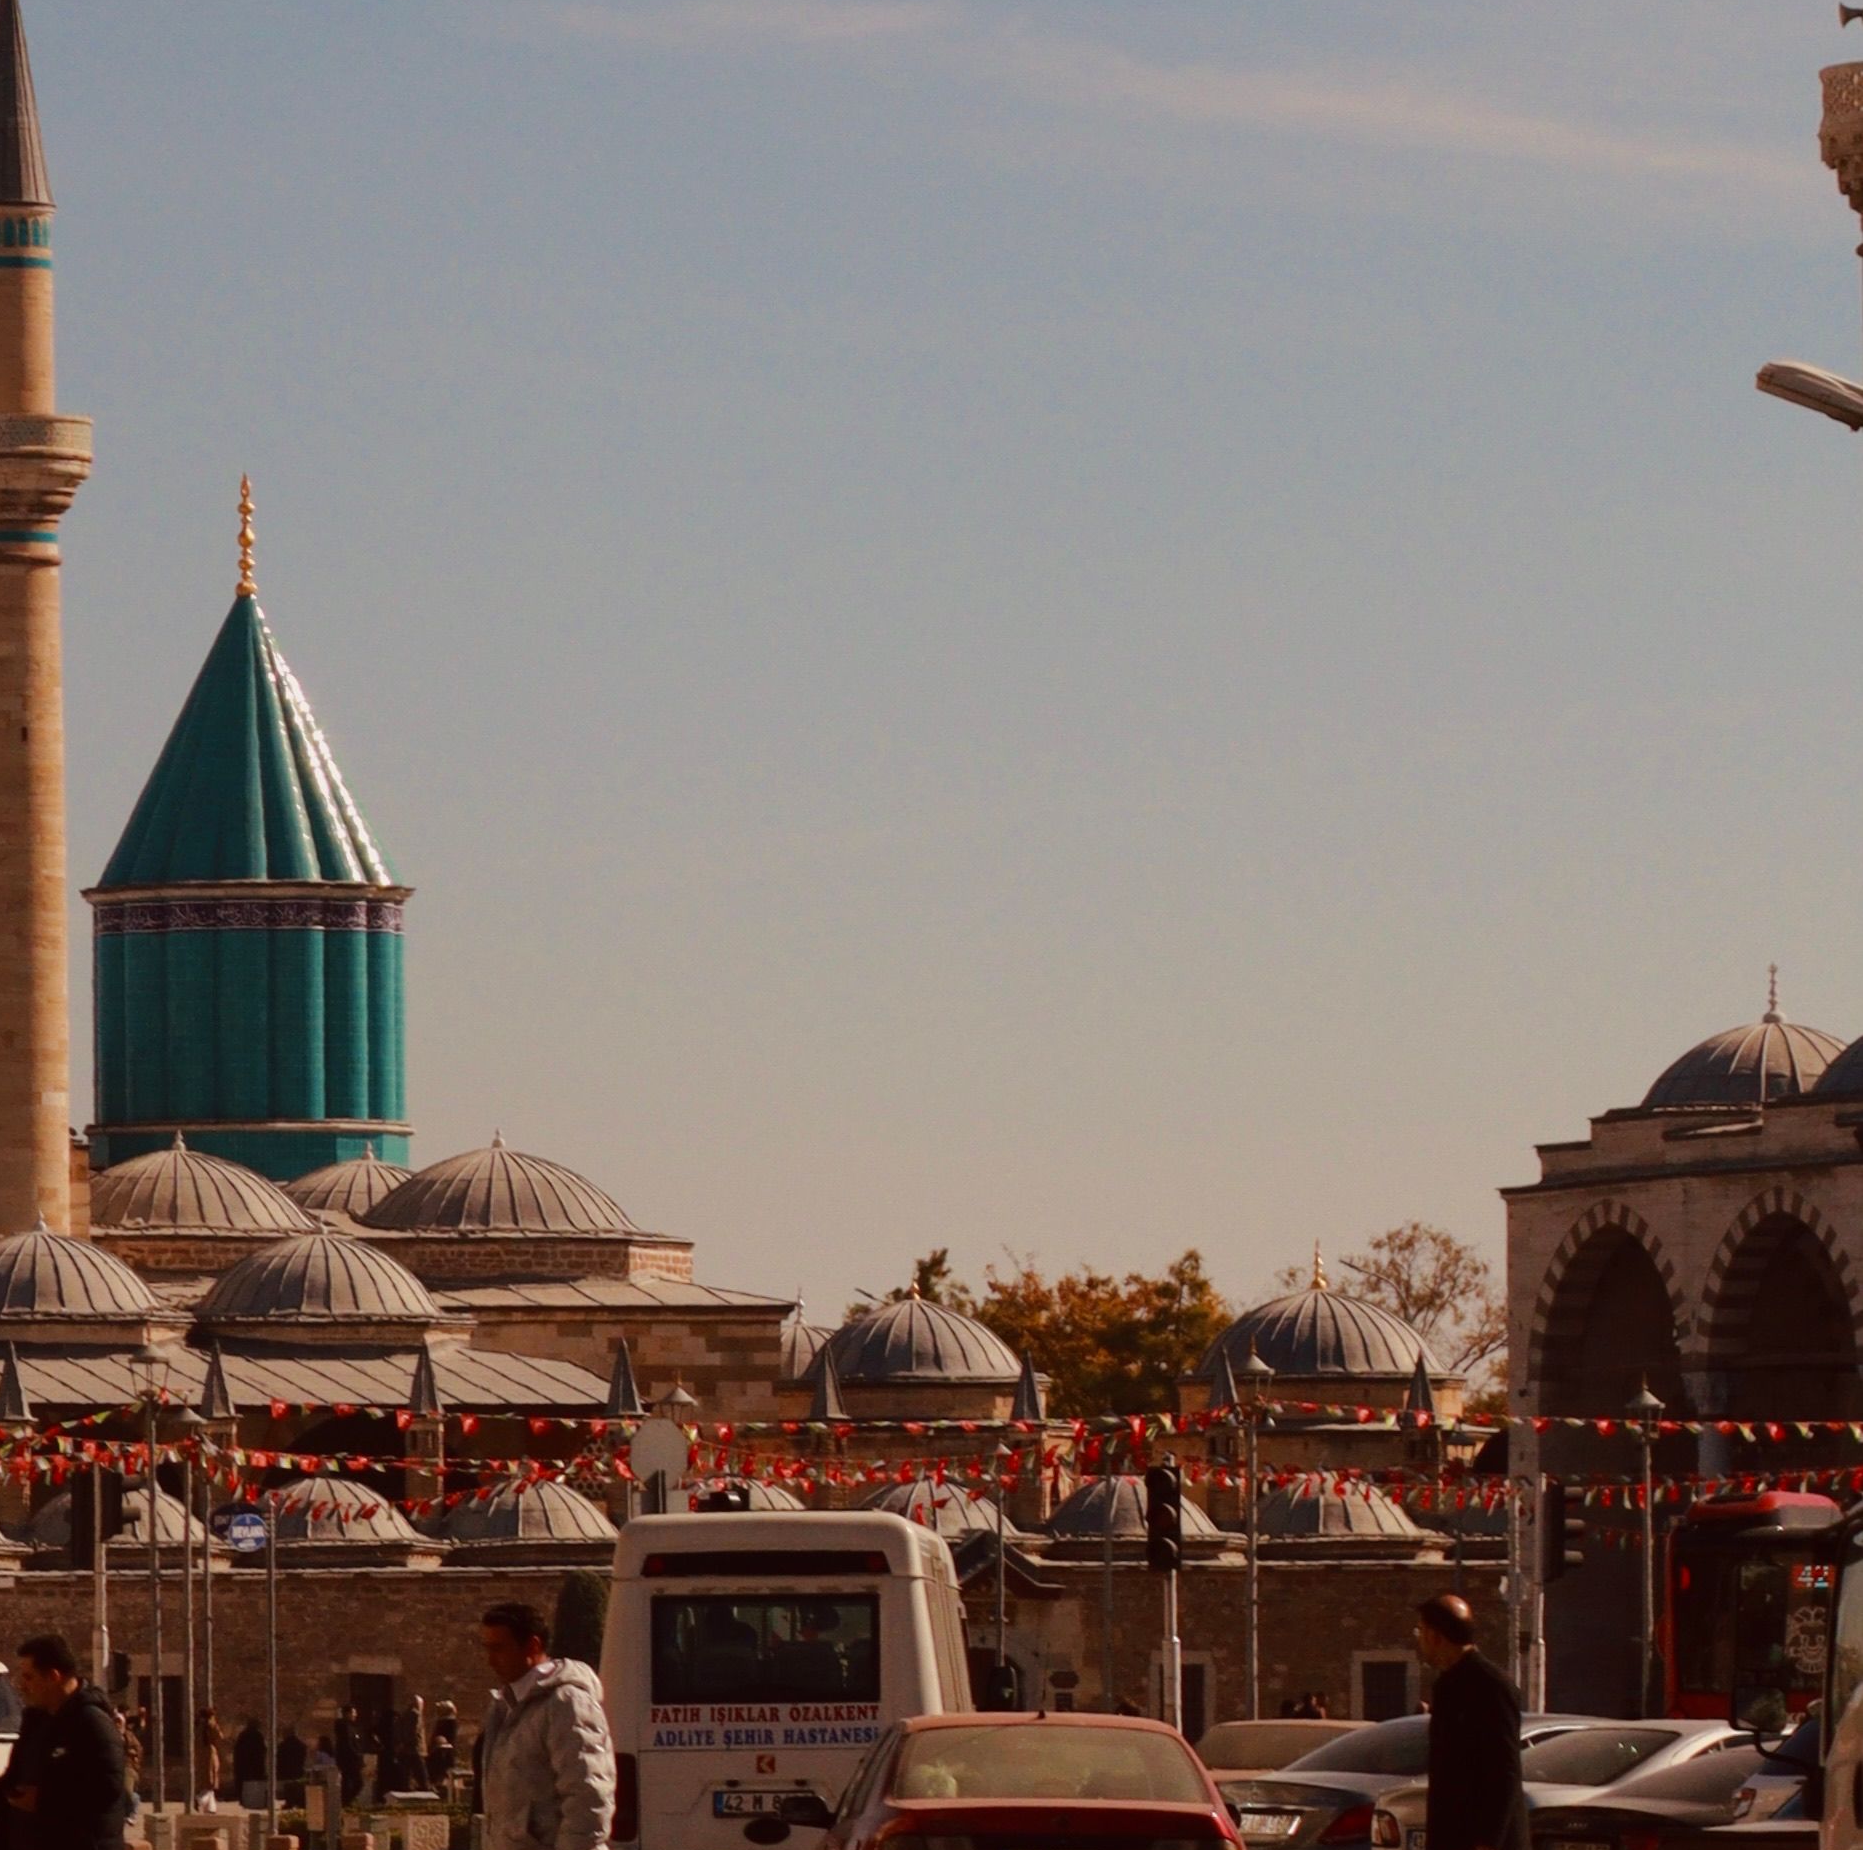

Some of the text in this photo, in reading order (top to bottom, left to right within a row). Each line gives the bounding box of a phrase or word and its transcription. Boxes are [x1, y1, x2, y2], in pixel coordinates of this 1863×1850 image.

[651, 1703, 880, 1726] FATİH IŞIKLAR ÖZALKENT
[724, 1795, 744, 1812] 42
[752, 1795, 764, 1811] M
